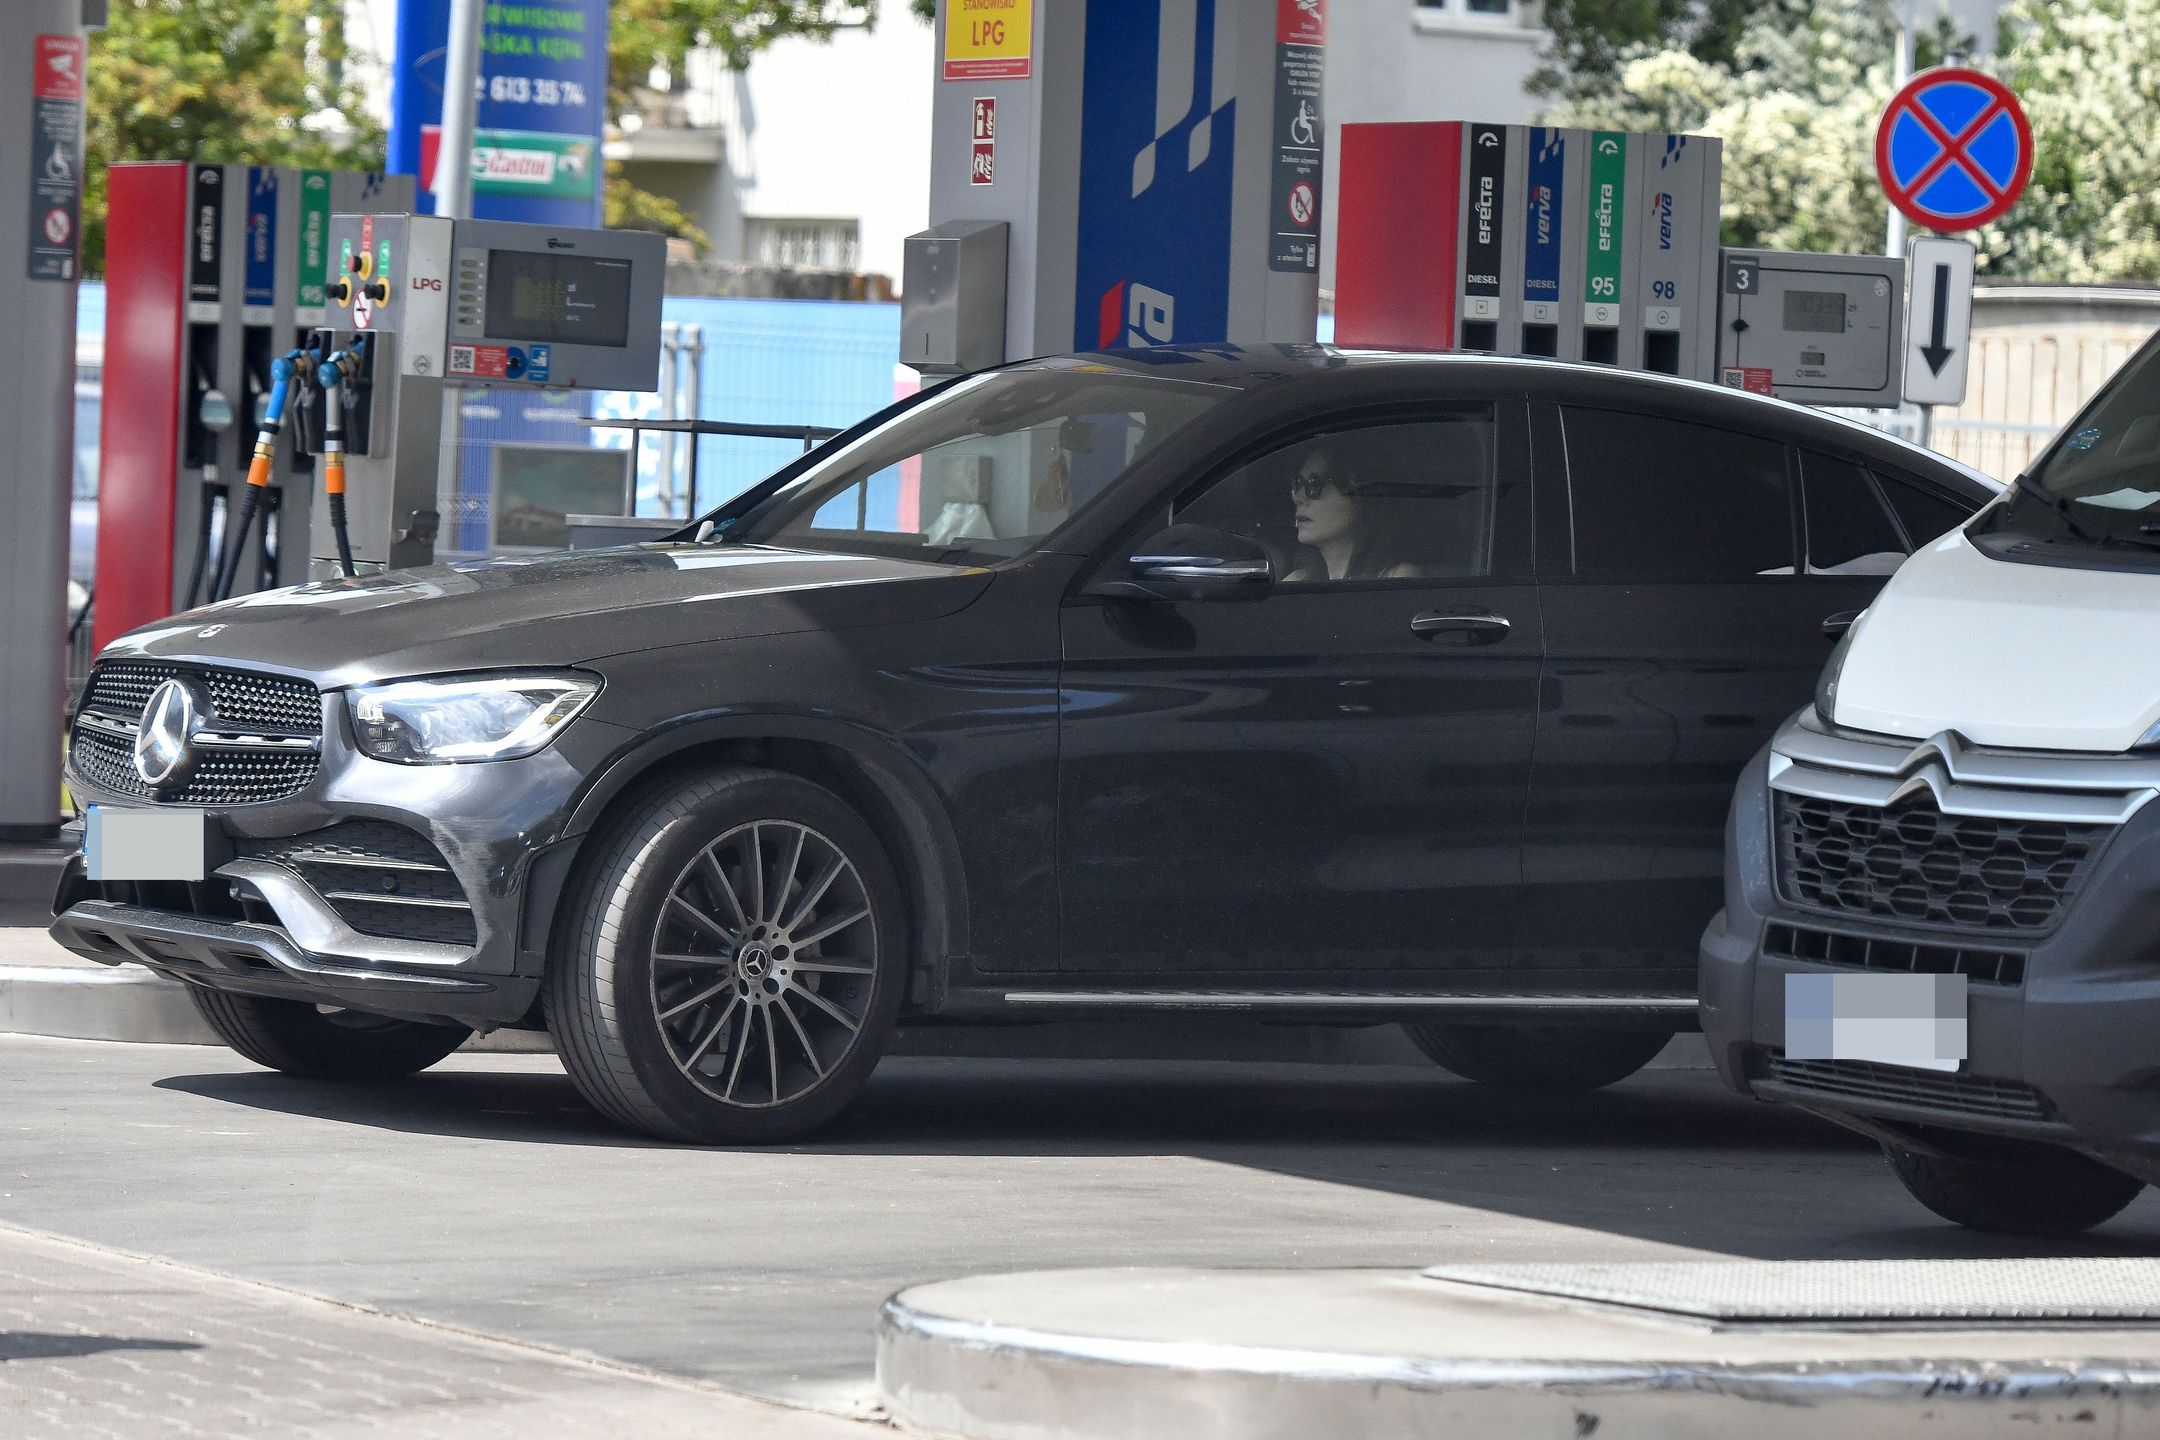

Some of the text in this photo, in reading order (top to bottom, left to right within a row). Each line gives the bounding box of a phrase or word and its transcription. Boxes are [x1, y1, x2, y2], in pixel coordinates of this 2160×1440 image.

[972, 20, 1005, 46] LPG
[412, 277, 442, 292] LPG
[1468, 274, 1498, 285] DIESEL
[1526, 279, 1557, 290] DIESEL
[1591, 276, 1615, 297] 95
[1736, 269, 1749, 290] 3
[1652, 280, 1675, 300] 98
